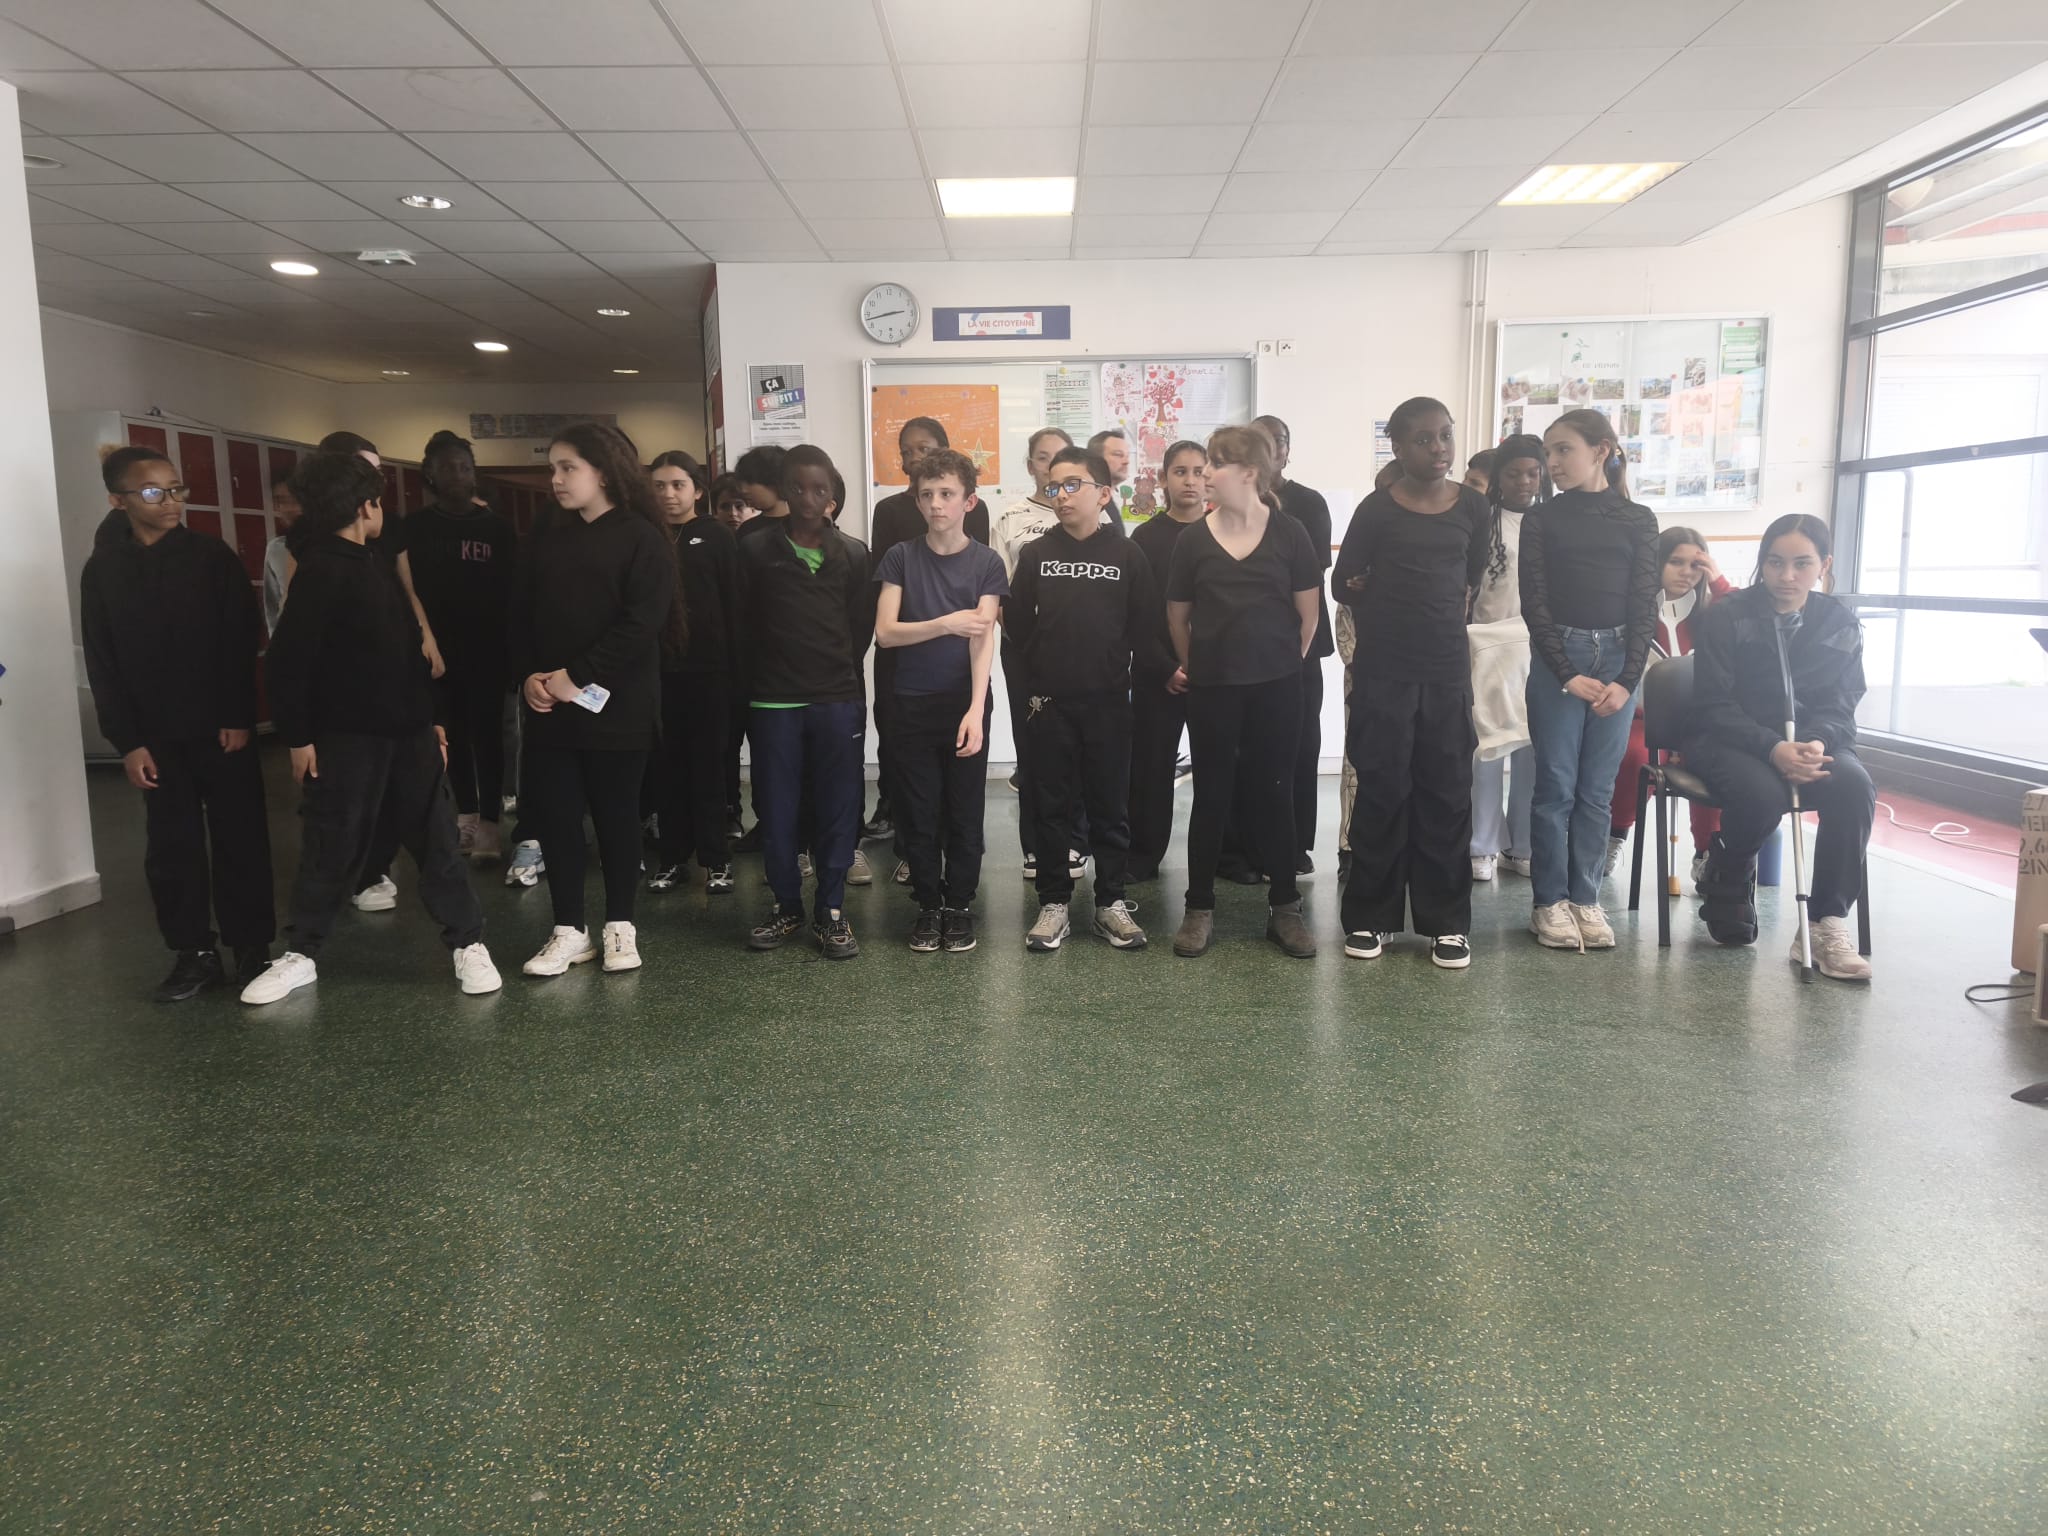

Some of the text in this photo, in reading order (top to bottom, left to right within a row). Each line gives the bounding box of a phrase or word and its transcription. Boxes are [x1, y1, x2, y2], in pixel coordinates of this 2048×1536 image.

[980, 320, 991, 328] VIE
[993, 319, 1035, 328] CITOYENNE
[765, 379, 779, 392] ÇA
[1040, 560, 1121, 581] Kappa
